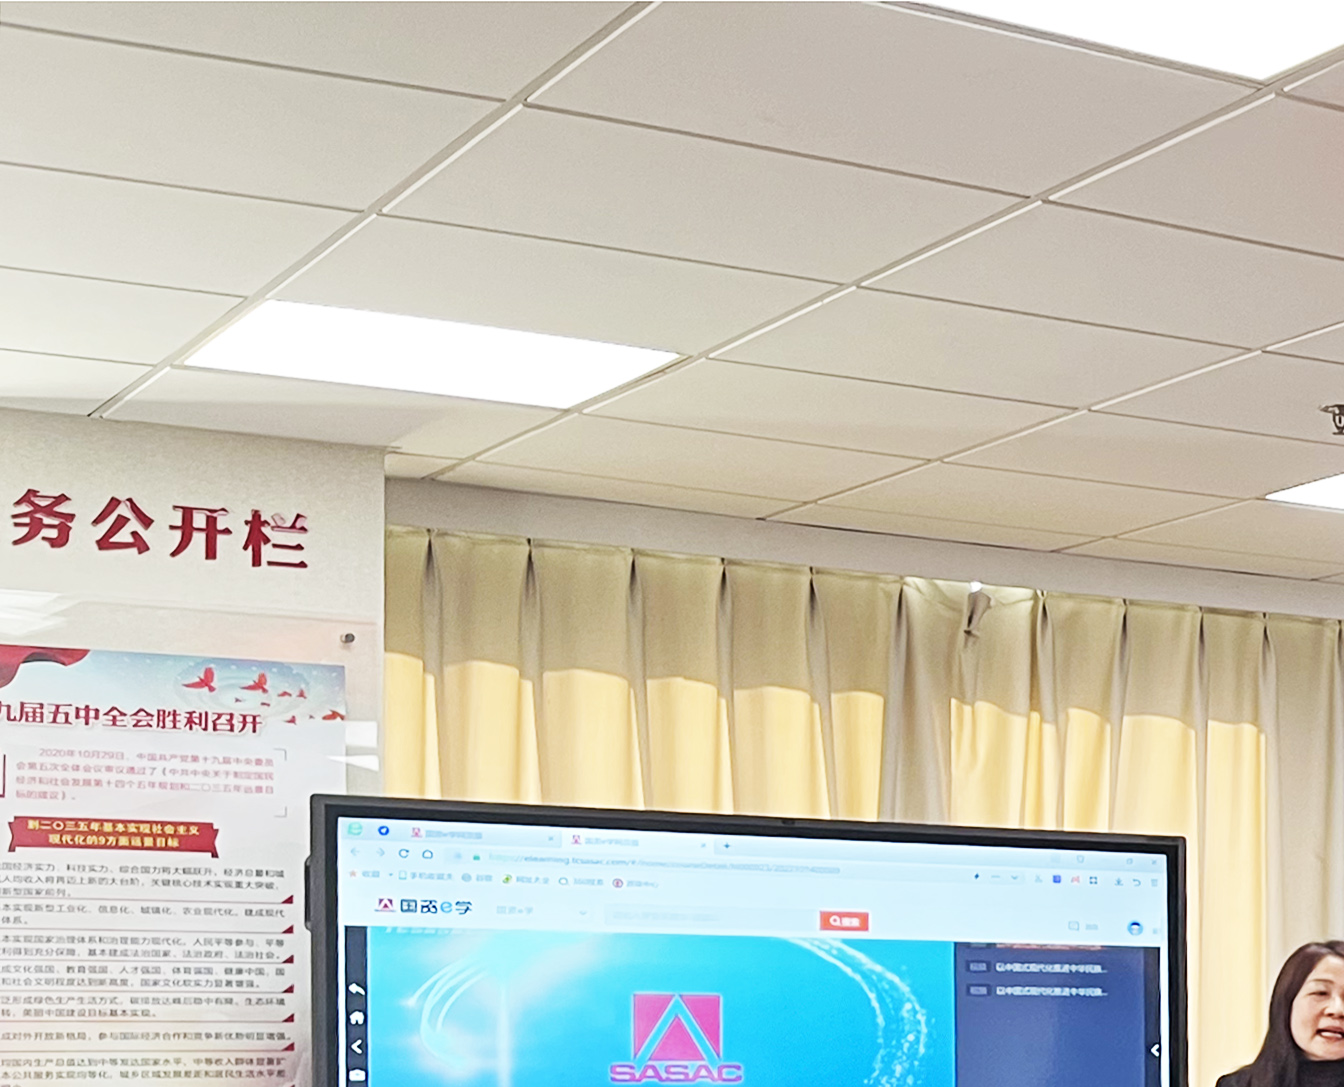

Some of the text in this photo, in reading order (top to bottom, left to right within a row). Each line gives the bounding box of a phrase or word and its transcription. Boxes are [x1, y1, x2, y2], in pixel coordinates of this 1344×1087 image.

[11, 488, 309, 569] 务公开栏
[609, 1063, 743, 1083] SASAC
